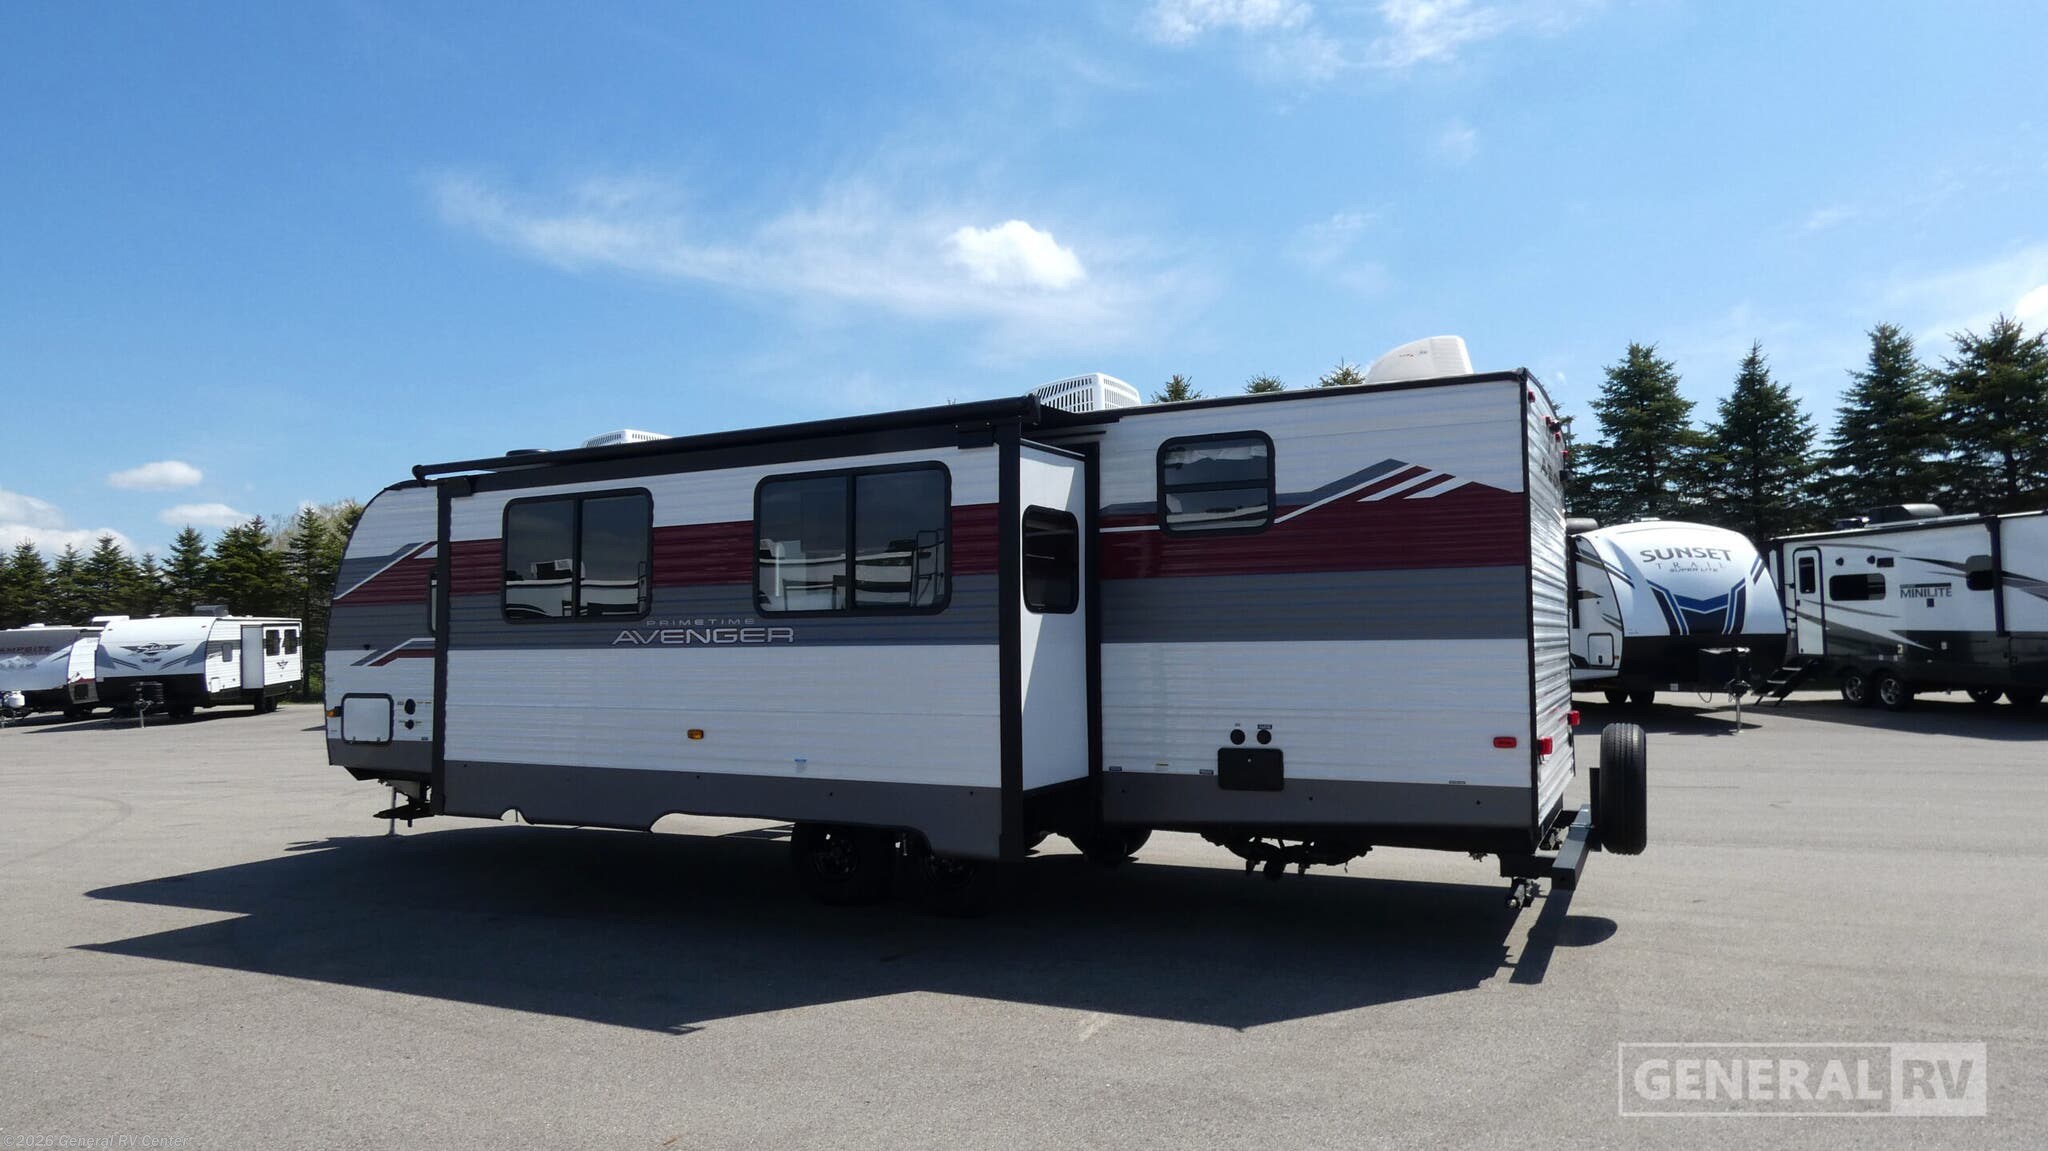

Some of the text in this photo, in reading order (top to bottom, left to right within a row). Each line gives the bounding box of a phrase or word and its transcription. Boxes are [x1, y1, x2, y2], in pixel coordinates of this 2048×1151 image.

[1640, 547, 1732, 563] SUNSET
[1655, 561, 1728, 570] TRAIL
[1899, 587, 1953, 599] MINILITE
[646, 618, 756, 627] PRIMETIME
[612, 627, 794, 645] AVENGER
